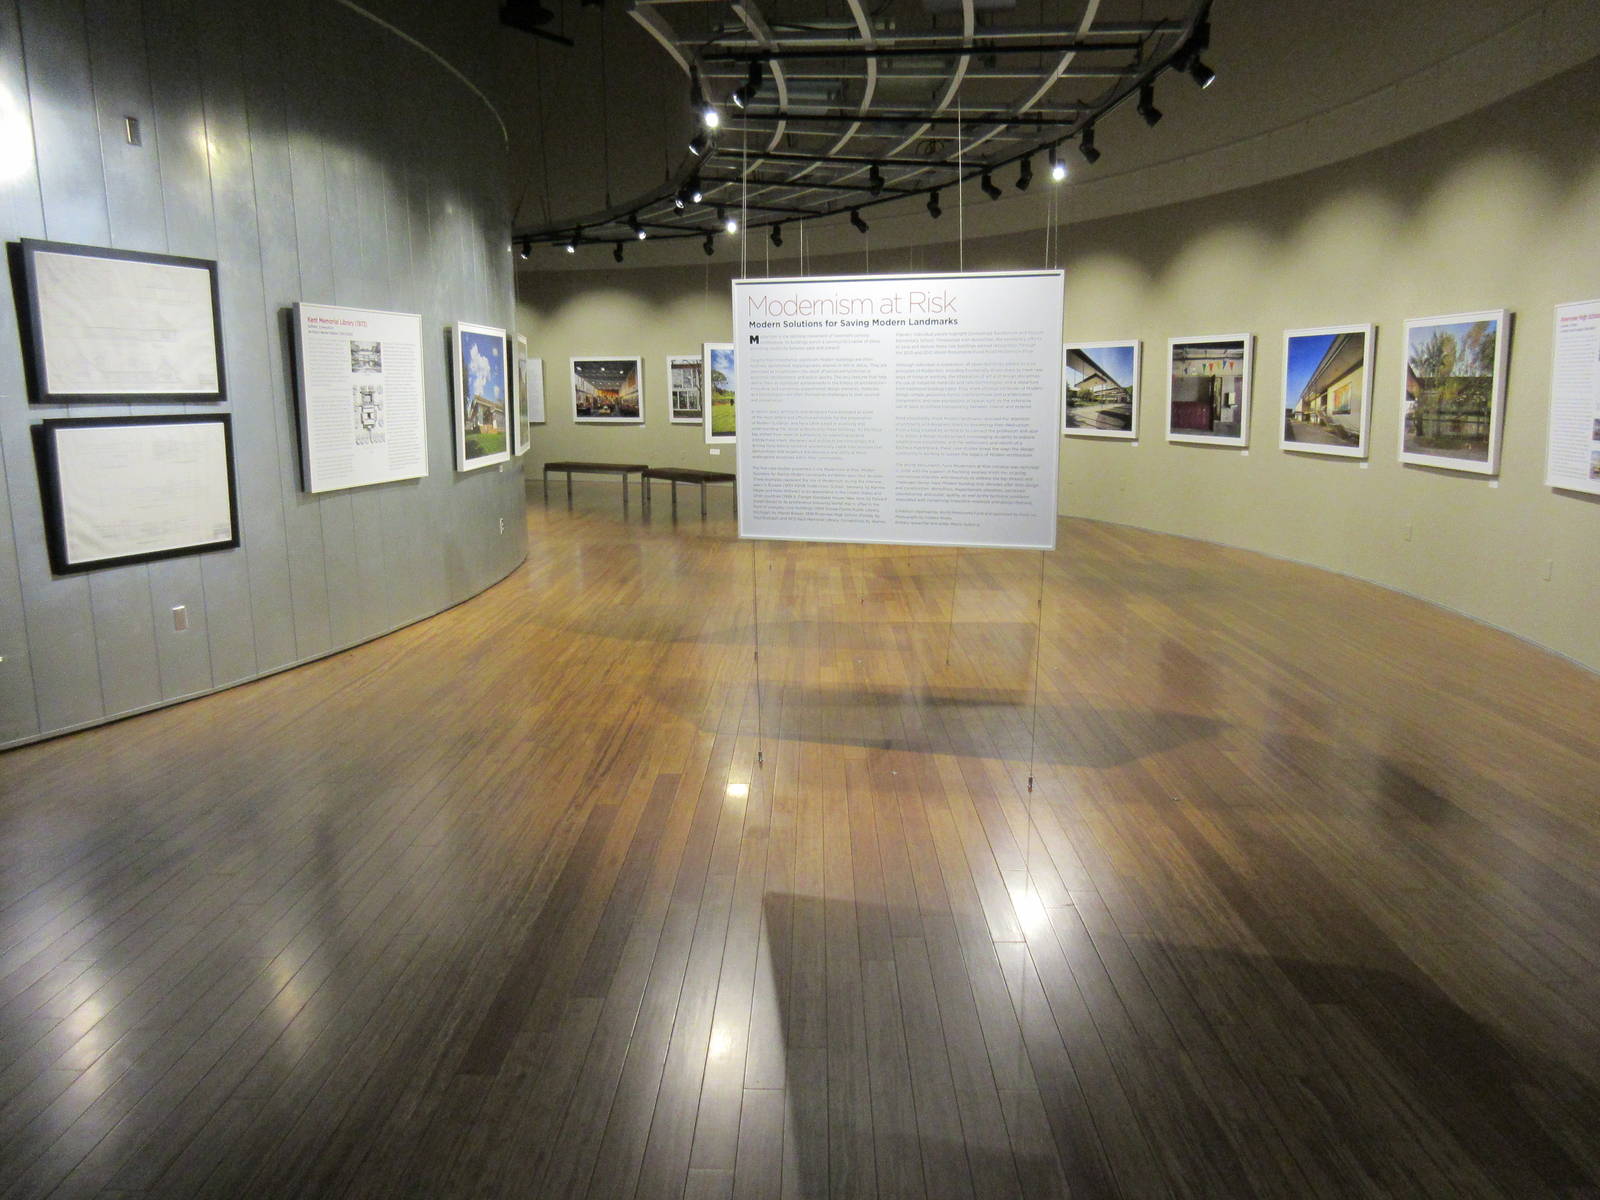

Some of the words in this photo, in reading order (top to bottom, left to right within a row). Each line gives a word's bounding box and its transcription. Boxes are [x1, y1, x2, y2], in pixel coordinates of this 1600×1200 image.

[748, 293, 874, 317] Modernism
[879, 292, 903, 315] at
[909, 289, 958, 314] Risk
[748, 320, 781, 329] Modern
[783, 319, 823, 328] Solutions
[825, 319, 837, 328] for
[840, 319, 870, 328] Saving
[872, 318, 906, 327] Modern
[908, 317, 958, 326] Landmarks
